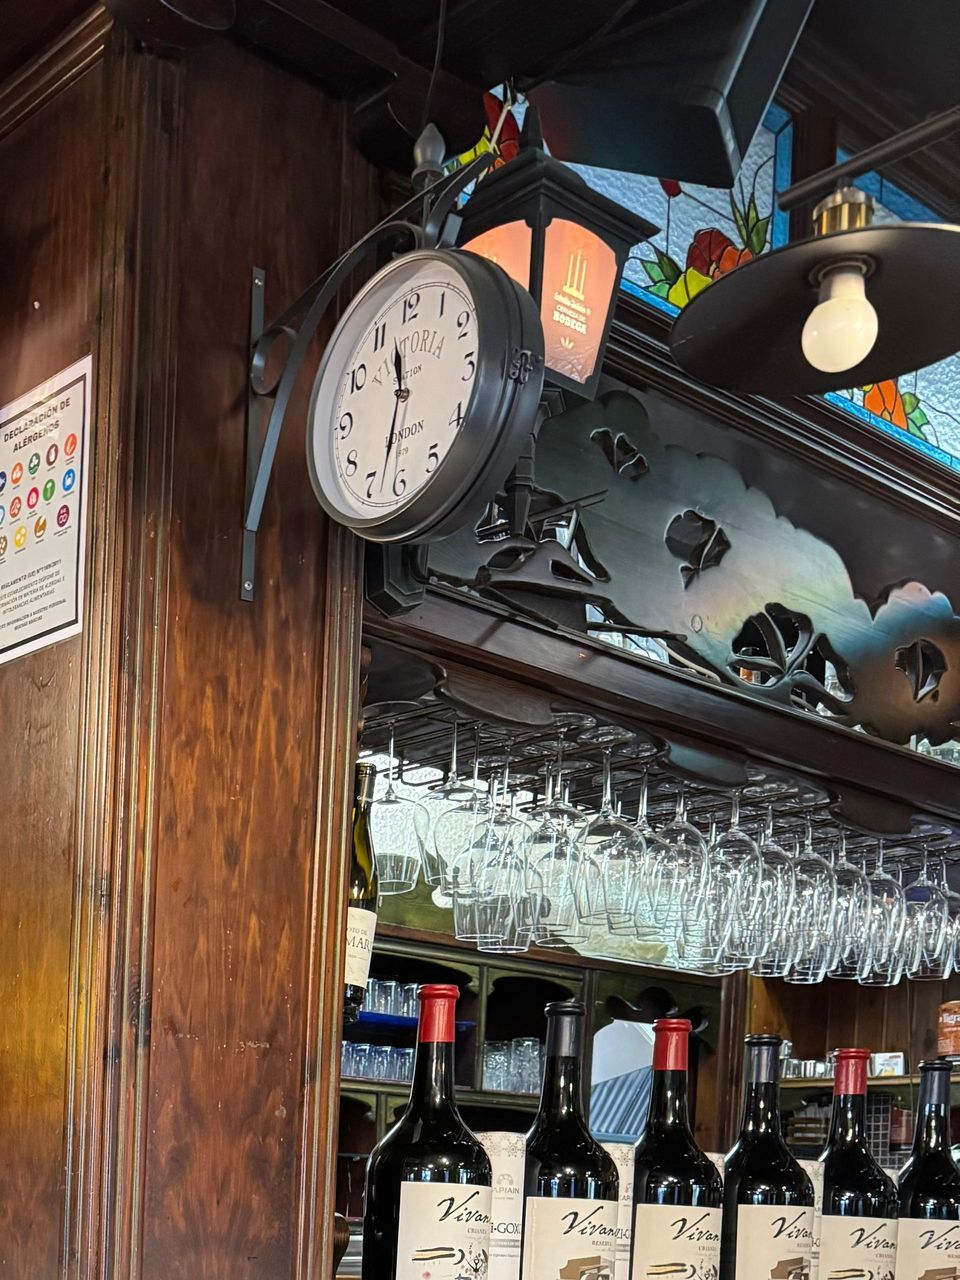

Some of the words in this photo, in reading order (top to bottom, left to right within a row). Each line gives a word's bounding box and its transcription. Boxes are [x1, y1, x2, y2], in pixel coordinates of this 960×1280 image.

[401, 292, 421, 325] 12
[440, 291, 445, 319] 1
[457, 310, 470, 340] 2
[553, 309, 587, 335] BODEGA
[373, 322, 386, 353] 11
[350, 363, 367, 395] 10
[393, 364, 422, 386] SATION
[461, 351, 475, 382] 3
[3, 404, 58, 443] DECLARACIÓN
[59, 397, 71, 411] DE
[339, 411, 354, 440] 9
[448, 400, 465, 430] 4
[12, 420, 60, 453] ALÉRGENOS
[345, 449, 358, 477] 8
[425, 442, 439, 474] 5
[365, 470, 377, 499] 7
[392, 468, 406, 497] 6
